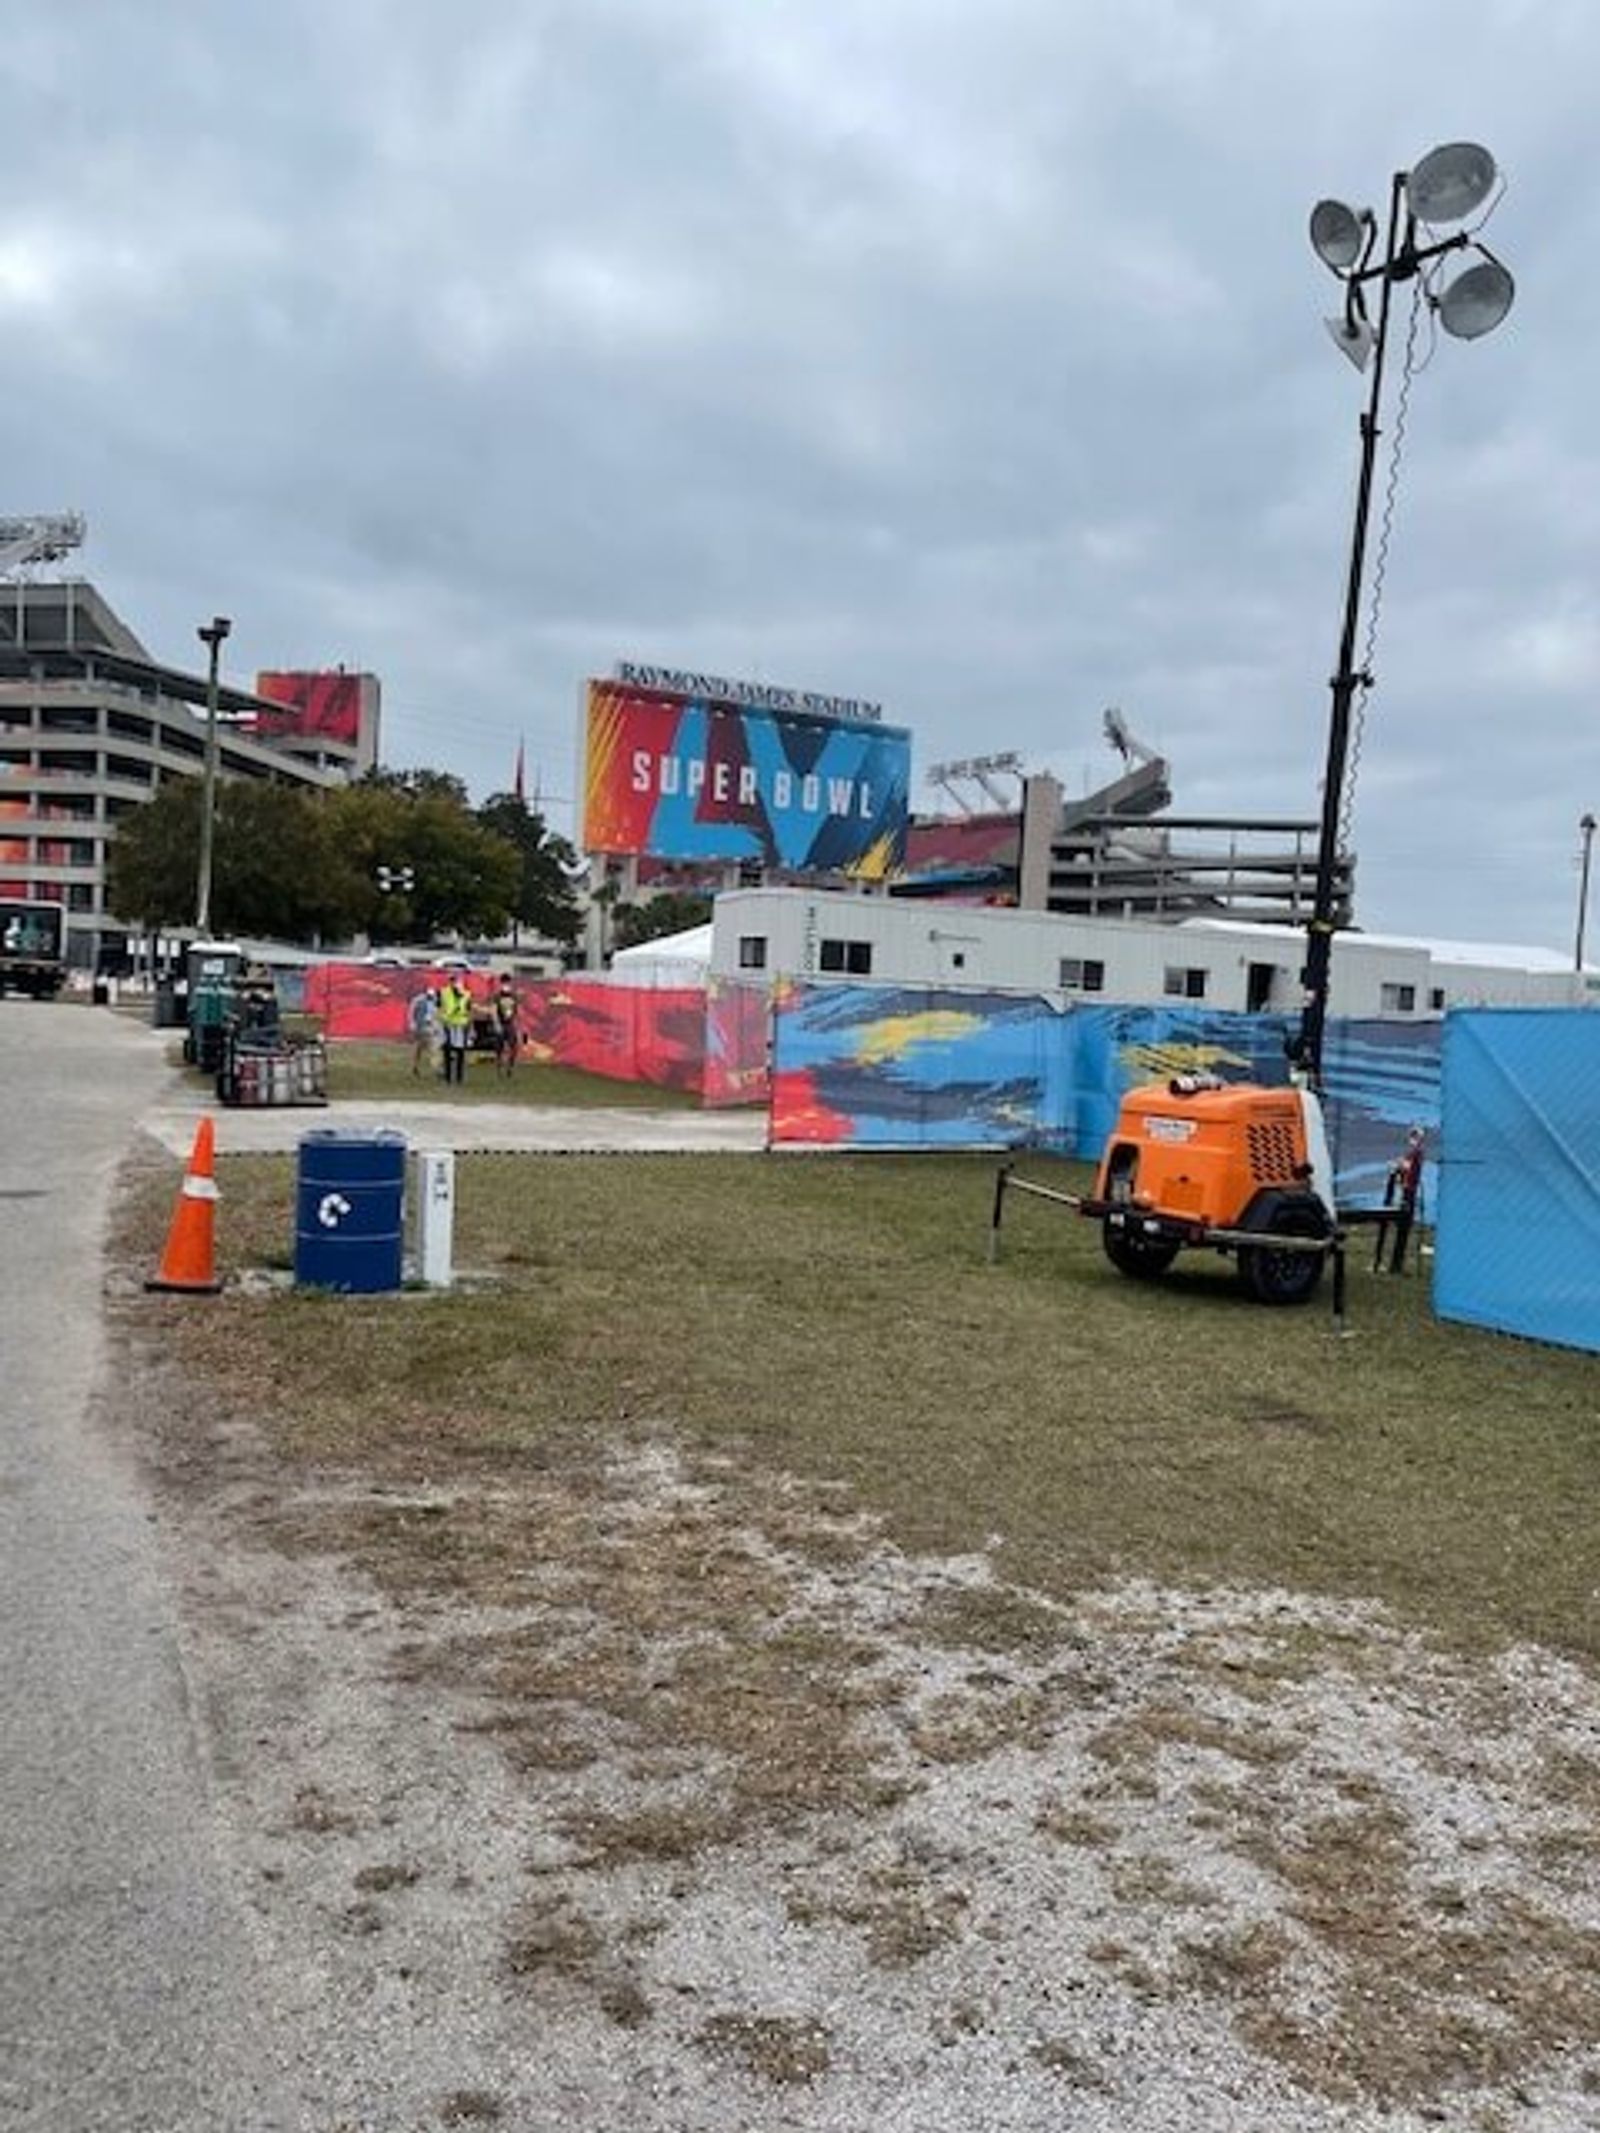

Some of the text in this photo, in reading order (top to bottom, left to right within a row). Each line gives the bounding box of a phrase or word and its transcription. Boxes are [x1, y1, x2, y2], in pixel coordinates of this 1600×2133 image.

[621, 663, 882, 721] RAYMOND JAMES STADIUM
[632, 751, 874, 819] SUPER BOWL
